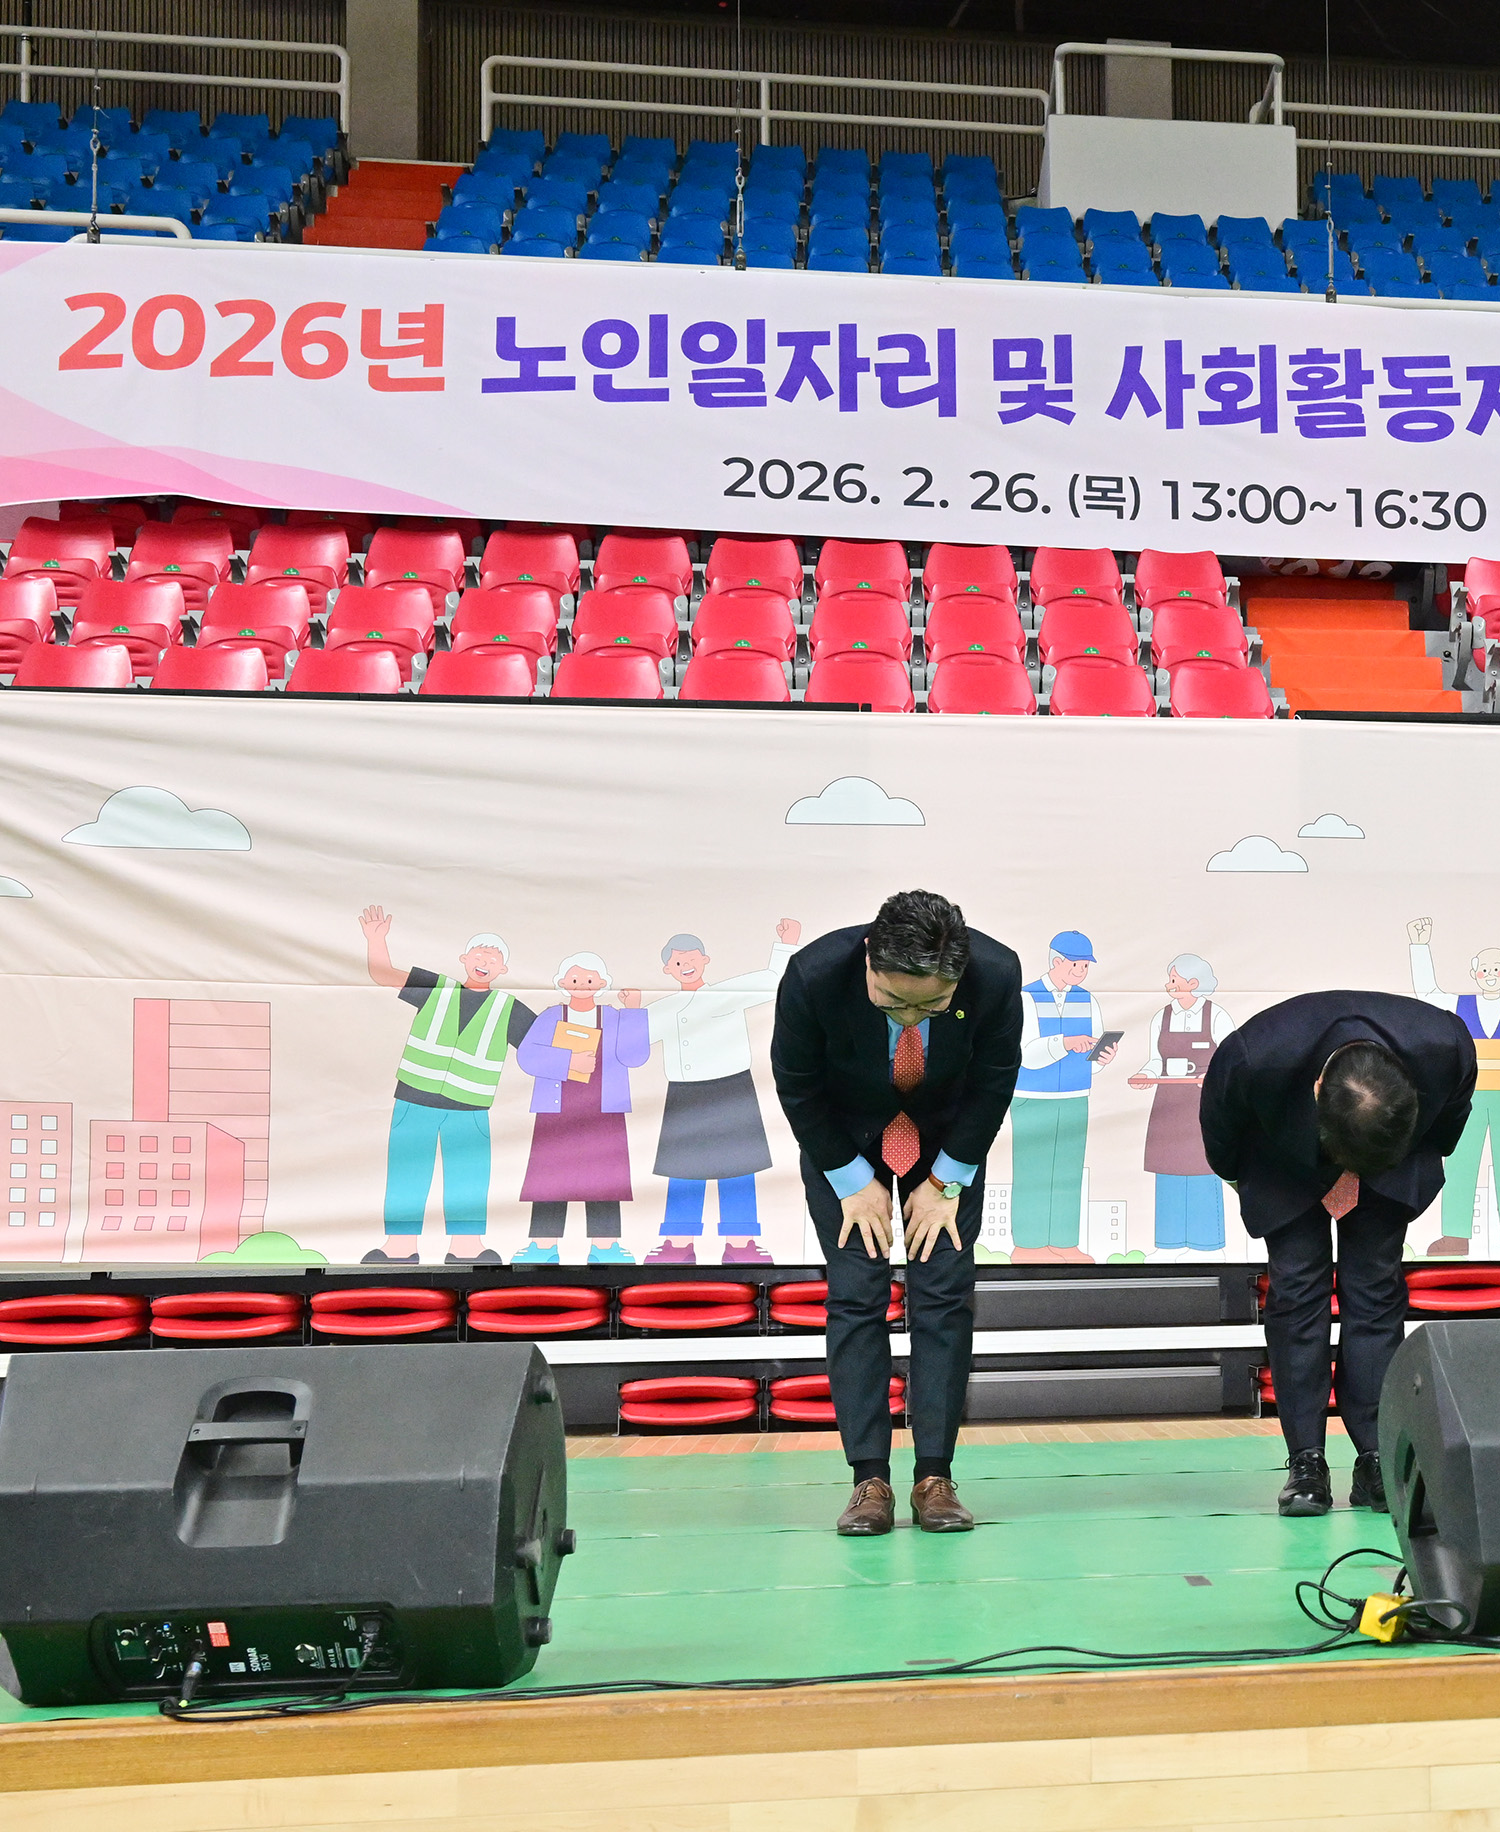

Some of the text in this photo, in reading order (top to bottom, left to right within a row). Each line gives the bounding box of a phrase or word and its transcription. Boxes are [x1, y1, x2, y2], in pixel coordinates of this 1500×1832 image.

[58, 292, 445, 393] 2026년
[481, 313, 957, 418] 노인일자리
[992, 334, 1077, 426] 및
[722, 456, 1487, 532] 2026. 2. 26. (목) 13:00~16:30
[246, 1647, 261, 1672] SONAR
